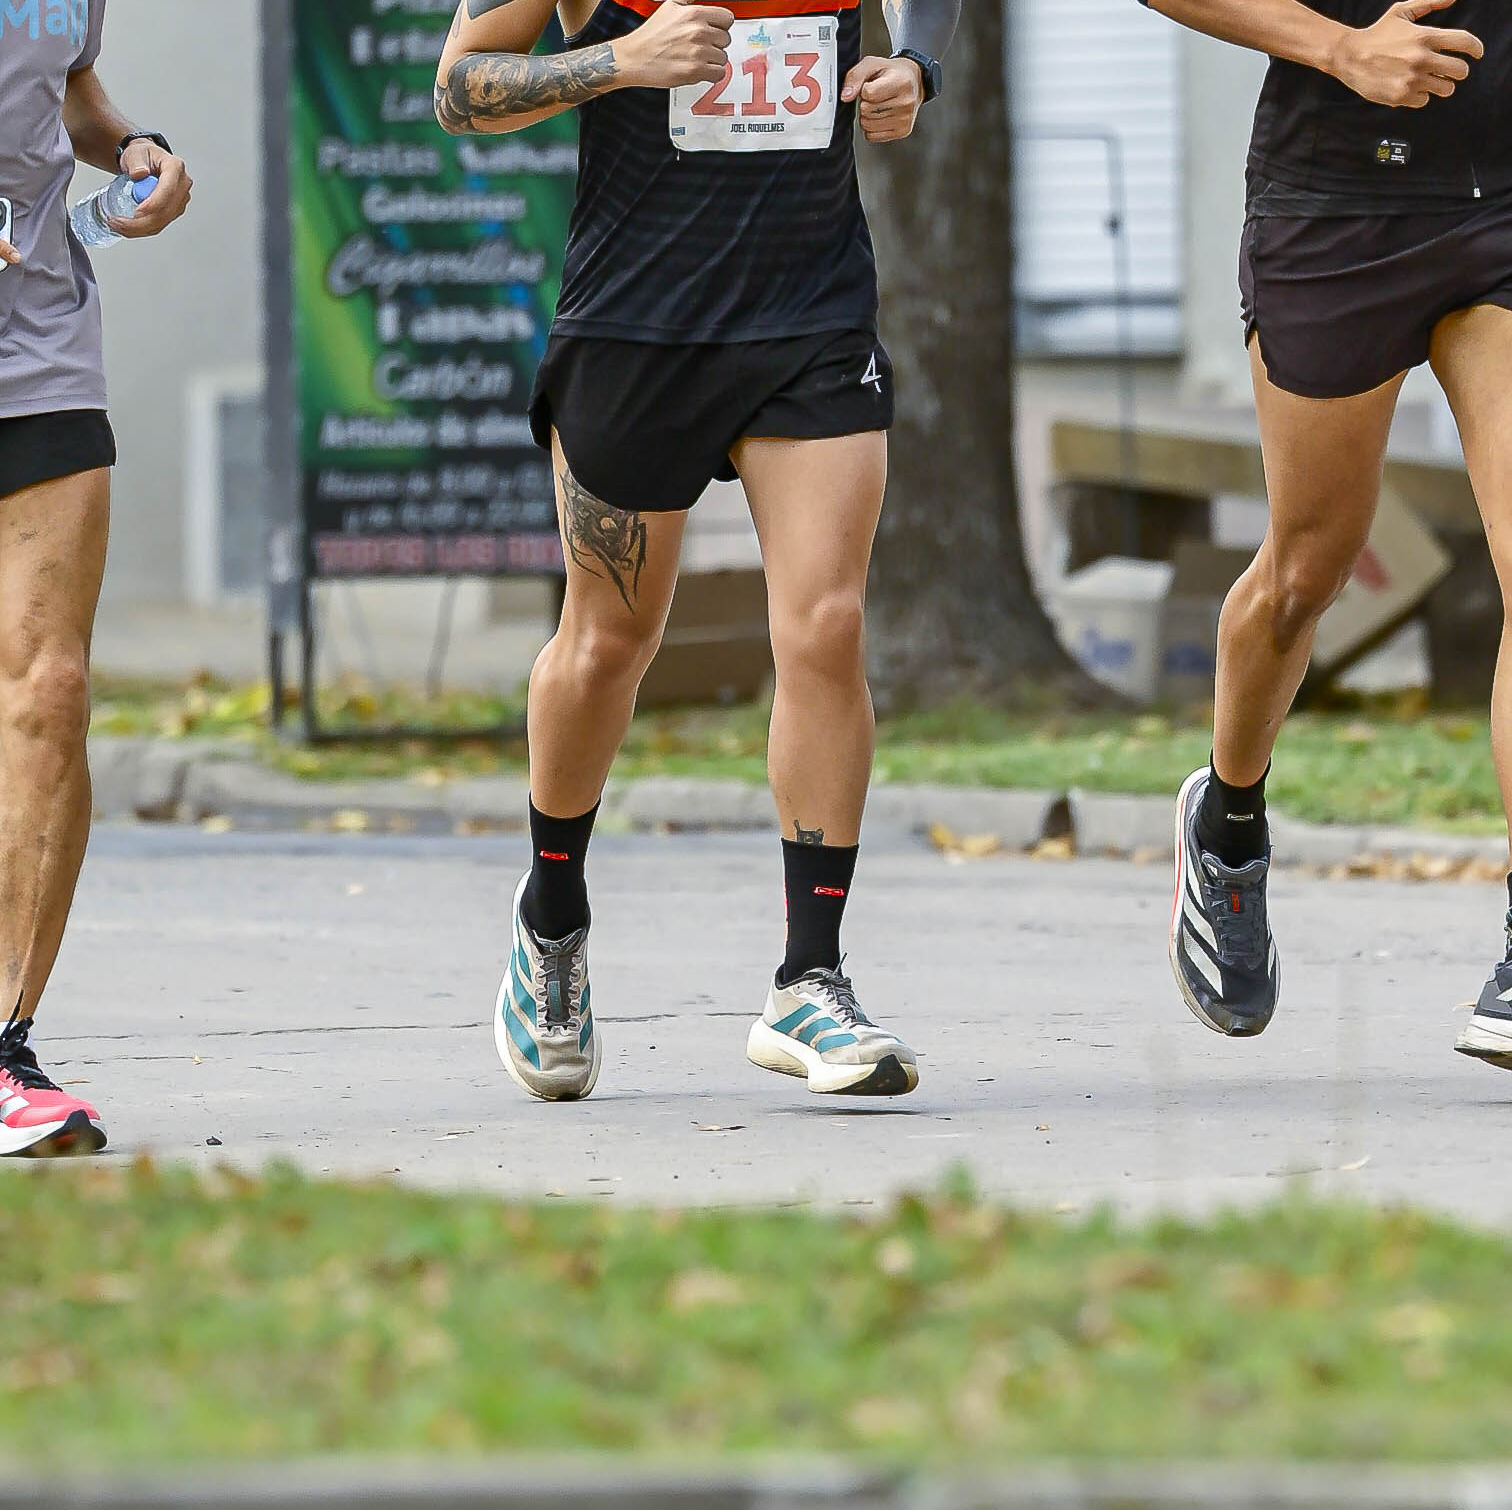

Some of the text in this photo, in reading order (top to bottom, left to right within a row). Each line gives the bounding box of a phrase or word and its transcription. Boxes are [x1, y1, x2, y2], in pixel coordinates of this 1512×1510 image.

[690, 52, 822, 116] 213
[730, 122, 785, 133] JOEL RIQUELMES
